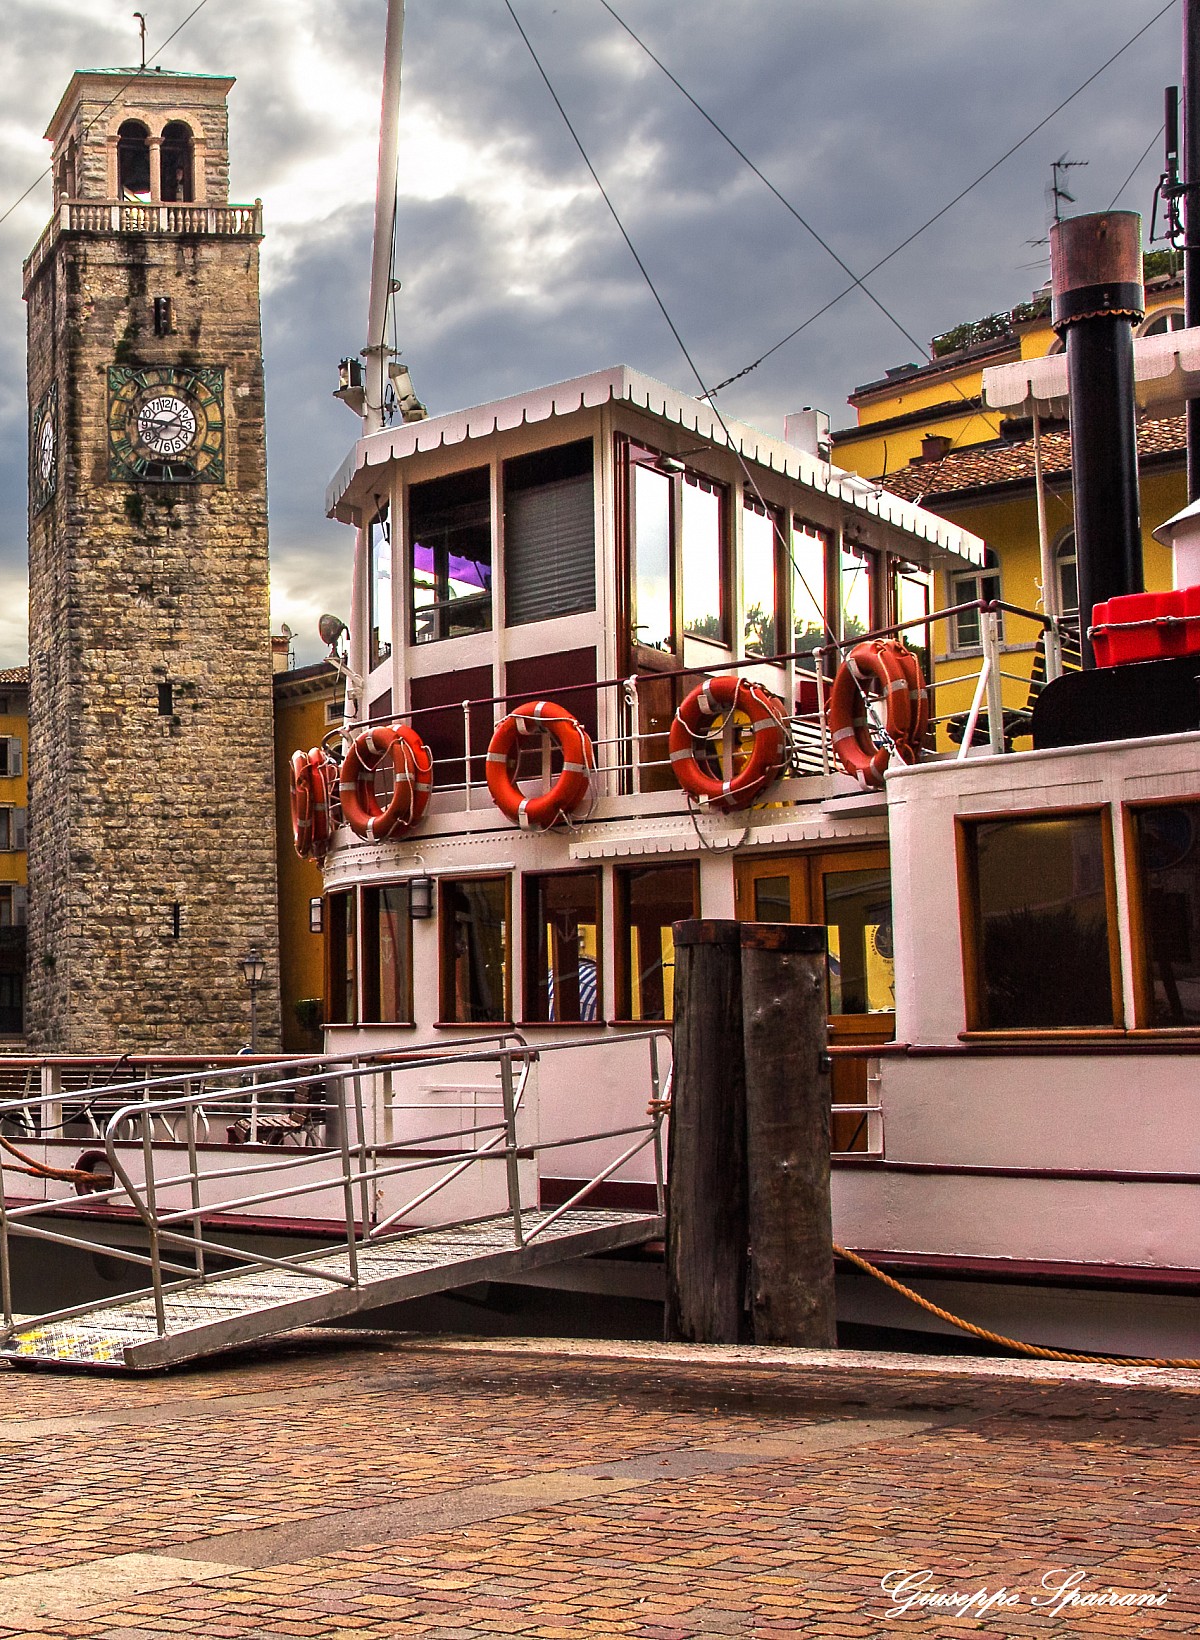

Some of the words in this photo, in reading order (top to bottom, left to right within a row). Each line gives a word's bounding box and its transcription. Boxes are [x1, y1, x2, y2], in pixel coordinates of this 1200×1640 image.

[151, 401, 160, 411] 11
[161, 399, 171, 409] 12
[174, 402, 178, 411] 1
[141, 409, 152, 419] 10
[182, 410, 189, 419] 2
[141, 420, 148, 430] 9
[185, 421, 192, 431] 3
[144, 431, 152, 441] 8
[182, 432, 189, 442] 4
[153, 440, 160, 449] 7
[163, 442, 171, 452] 6
[174, 440, 181, 450] 5
